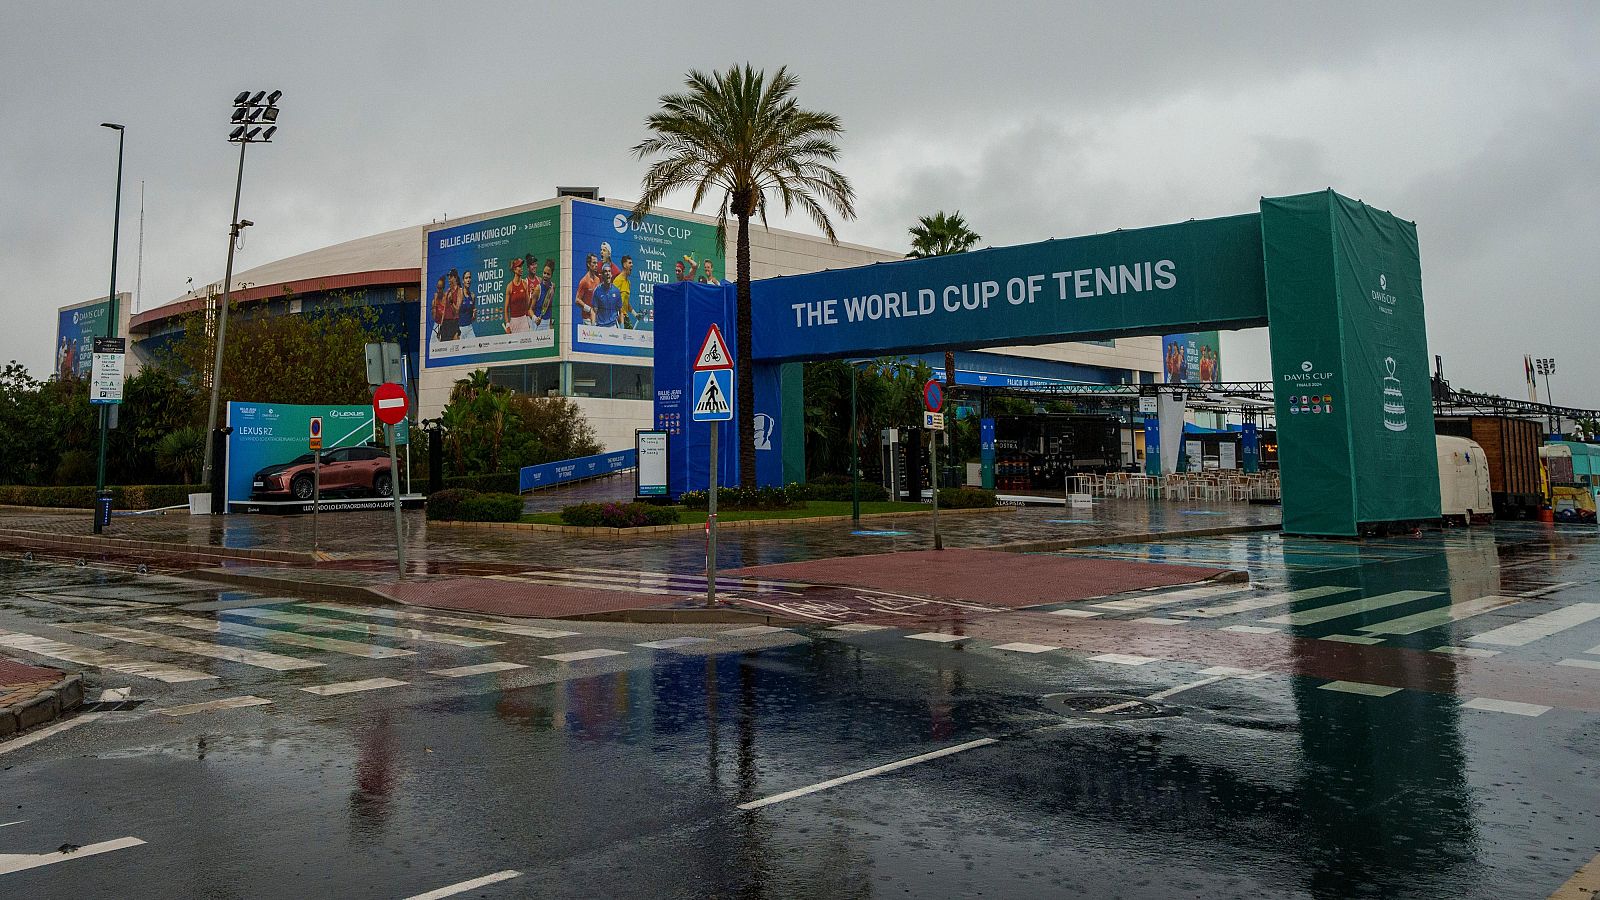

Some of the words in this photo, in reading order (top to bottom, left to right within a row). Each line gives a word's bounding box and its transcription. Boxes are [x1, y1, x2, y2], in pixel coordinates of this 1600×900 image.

[631, 220, 665, 236] DAVIS
[667, 226, 692, 240] CUP
[440, 235, 461, 249] BILLIE
[461, 232, 481, 245] JEAN
[481, 228, 500, 241] KING
[500, 224, 517, 237] CUP
[483, 257, 498, 269] THE
[646, 260, 663, 271] THE
[477, 269, 504, 281] WORLD
[639, 270, 669, 284] WORLD
[477, 282, 493, 294] CUP
[493, 280, 504, 291] OF
[476, 293, 504, 306] TENNIS
[792, 299, 838, 328] THE
[843, 289, 936, 323] WORLD
[943, 280, 1000, 313] CUP
[1006, 274, 1045, 305] OF
[1053, 259, 1177, 300] TENNIS
[639, 294, 655, 306] TEN
[1284, 373, 1311, 381] DAVIS
[1312, 372, 1333, 380] CUP
[239, 426, 263, 435] LEXUS
[263, 427, 273, 436] RZ
[302, 504, 328, 512] LLEVNDO
[335, 502, 377, 511] EXTRAORDINARIO
